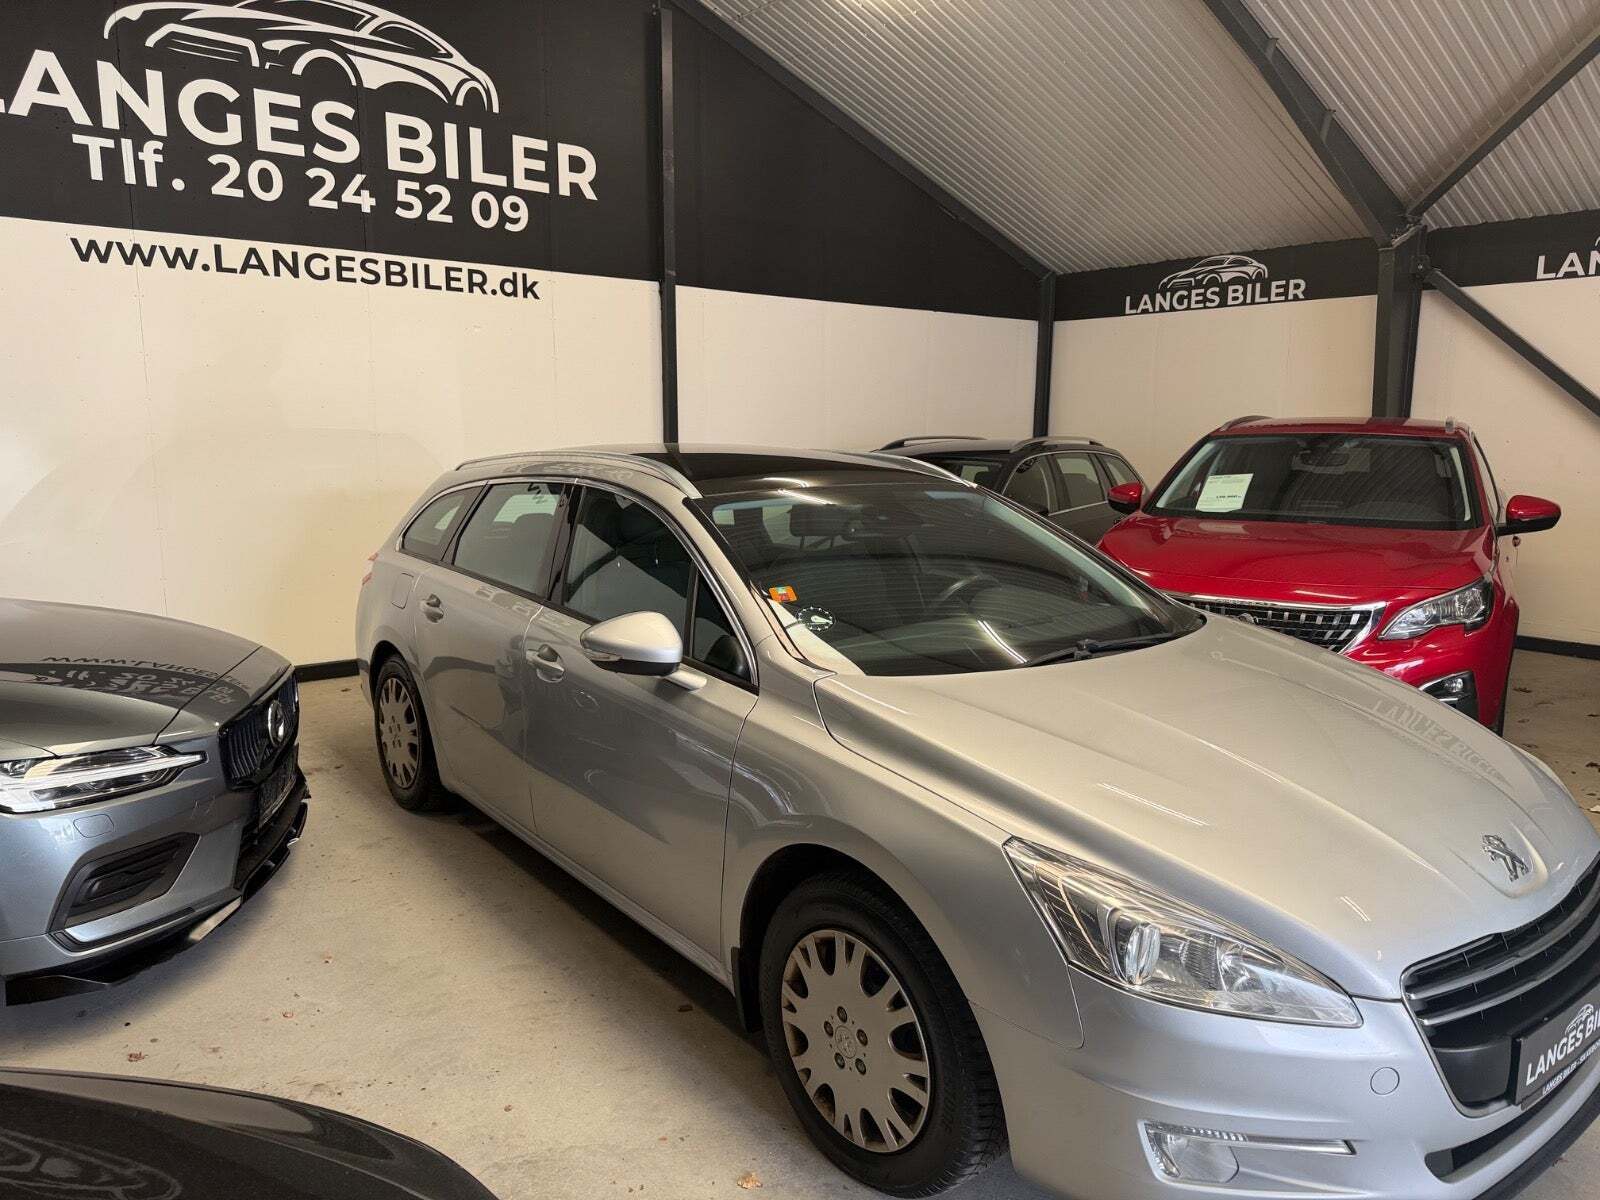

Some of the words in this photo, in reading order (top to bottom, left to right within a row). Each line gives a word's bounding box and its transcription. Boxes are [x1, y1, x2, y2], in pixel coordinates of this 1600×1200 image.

[0, 48, 361, 164] ANGES
[384, 111, 598, 201] BILER
[71, 133, 186, 191] Tlf.
[207, 153, 284, 202] 20
[304, 167, 377, 214] 24
[394, 179, 454, 224] 52
[471, 190, 529, 232] 09
[70, 236, 540, 300] www.LANGESBILER.dk
[1125, 286, 1220, 315] LANGES
[1227, 278, 1306, 306] BILER
[1526, 1024, 1584, 1086] LANGES
